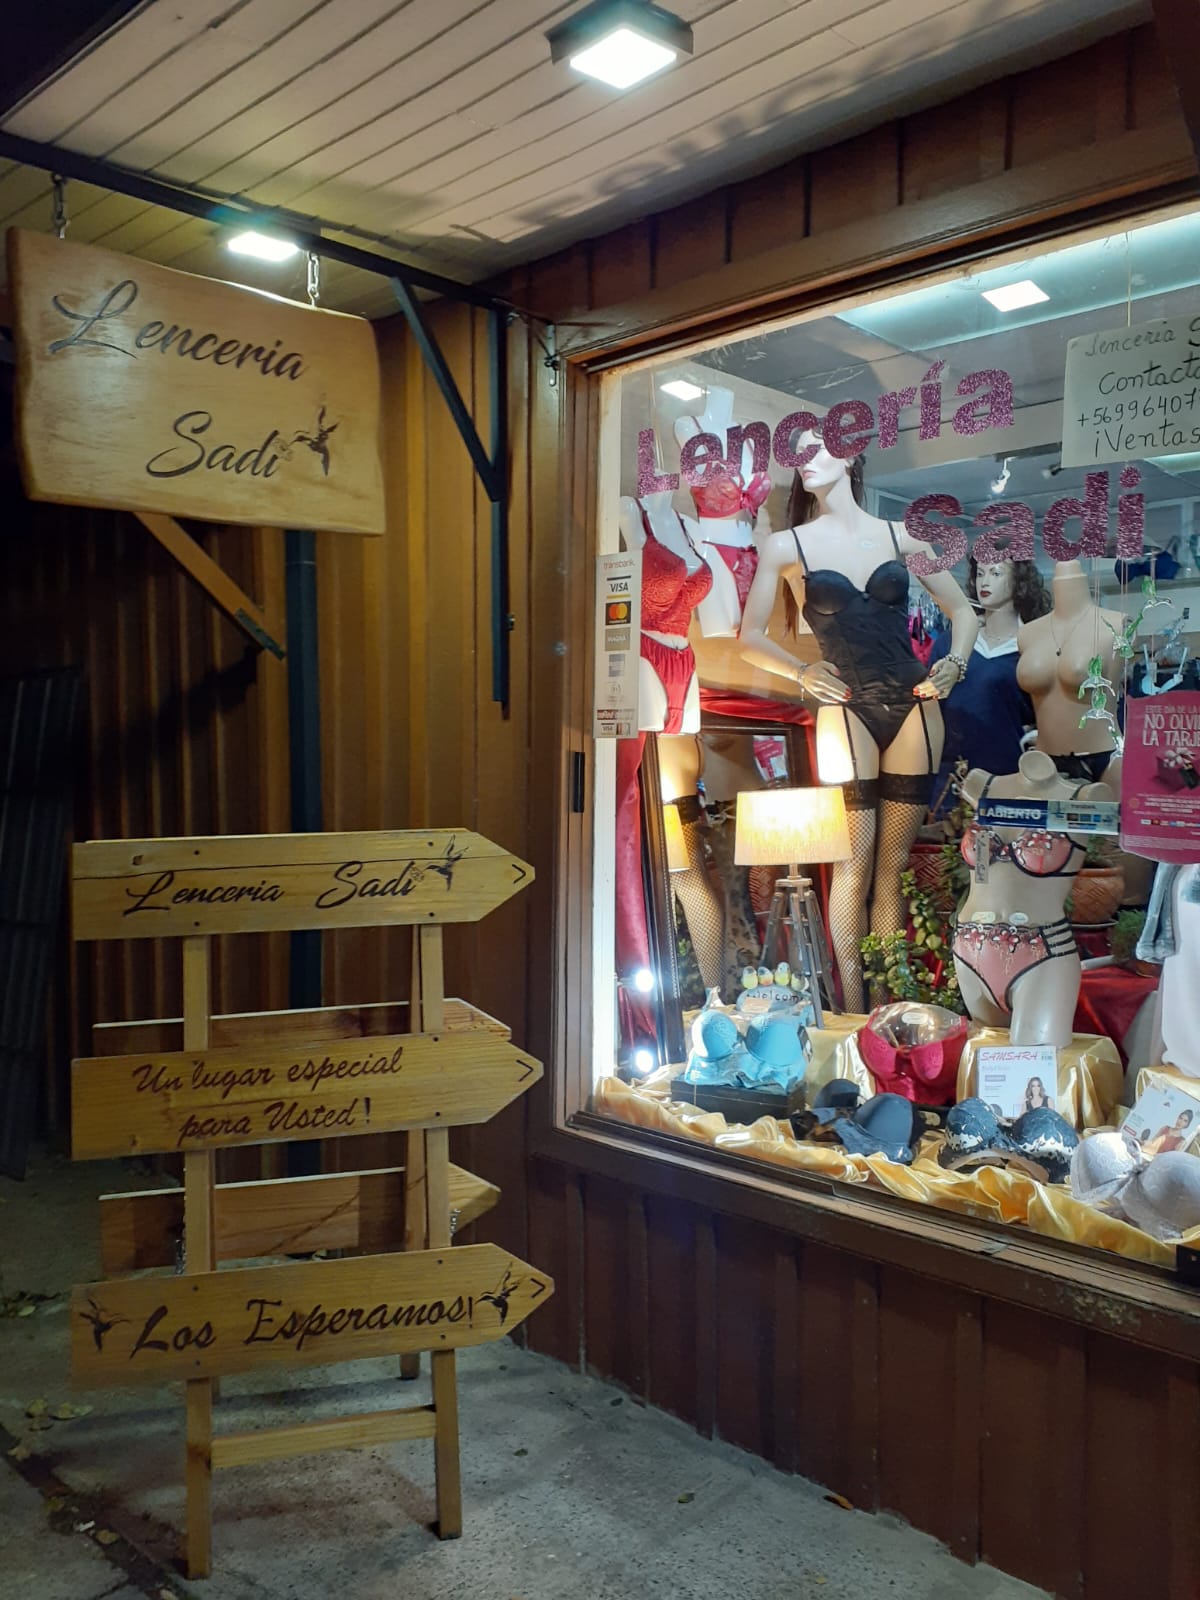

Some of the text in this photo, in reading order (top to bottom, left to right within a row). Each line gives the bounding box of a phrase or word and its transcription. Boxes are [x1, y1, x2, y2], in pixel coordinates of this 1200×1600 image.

[48, 279, 308, 381] Lenceria
[637, 359, 1017, 499] Lencería
[1077, 386, 1200, 427] +56996407
[146, 410, 281, 479] Sadi
[904, 466, 1146, 577] Sadi
[610, 582, 628, 593] VISA
[1142, 730, 1159, 746] LA
[1144, 714, 1165, 730] NO
[986, 805, 1042, 820] ABIERTO
[123, 860, 417, 916] Lenceria Sadi
[131, 1046, 404, 1099] Un lugar especial
[177, 1111, 253, 1146] para
[129, 1295, 475, 1360] Los Esperamos!
